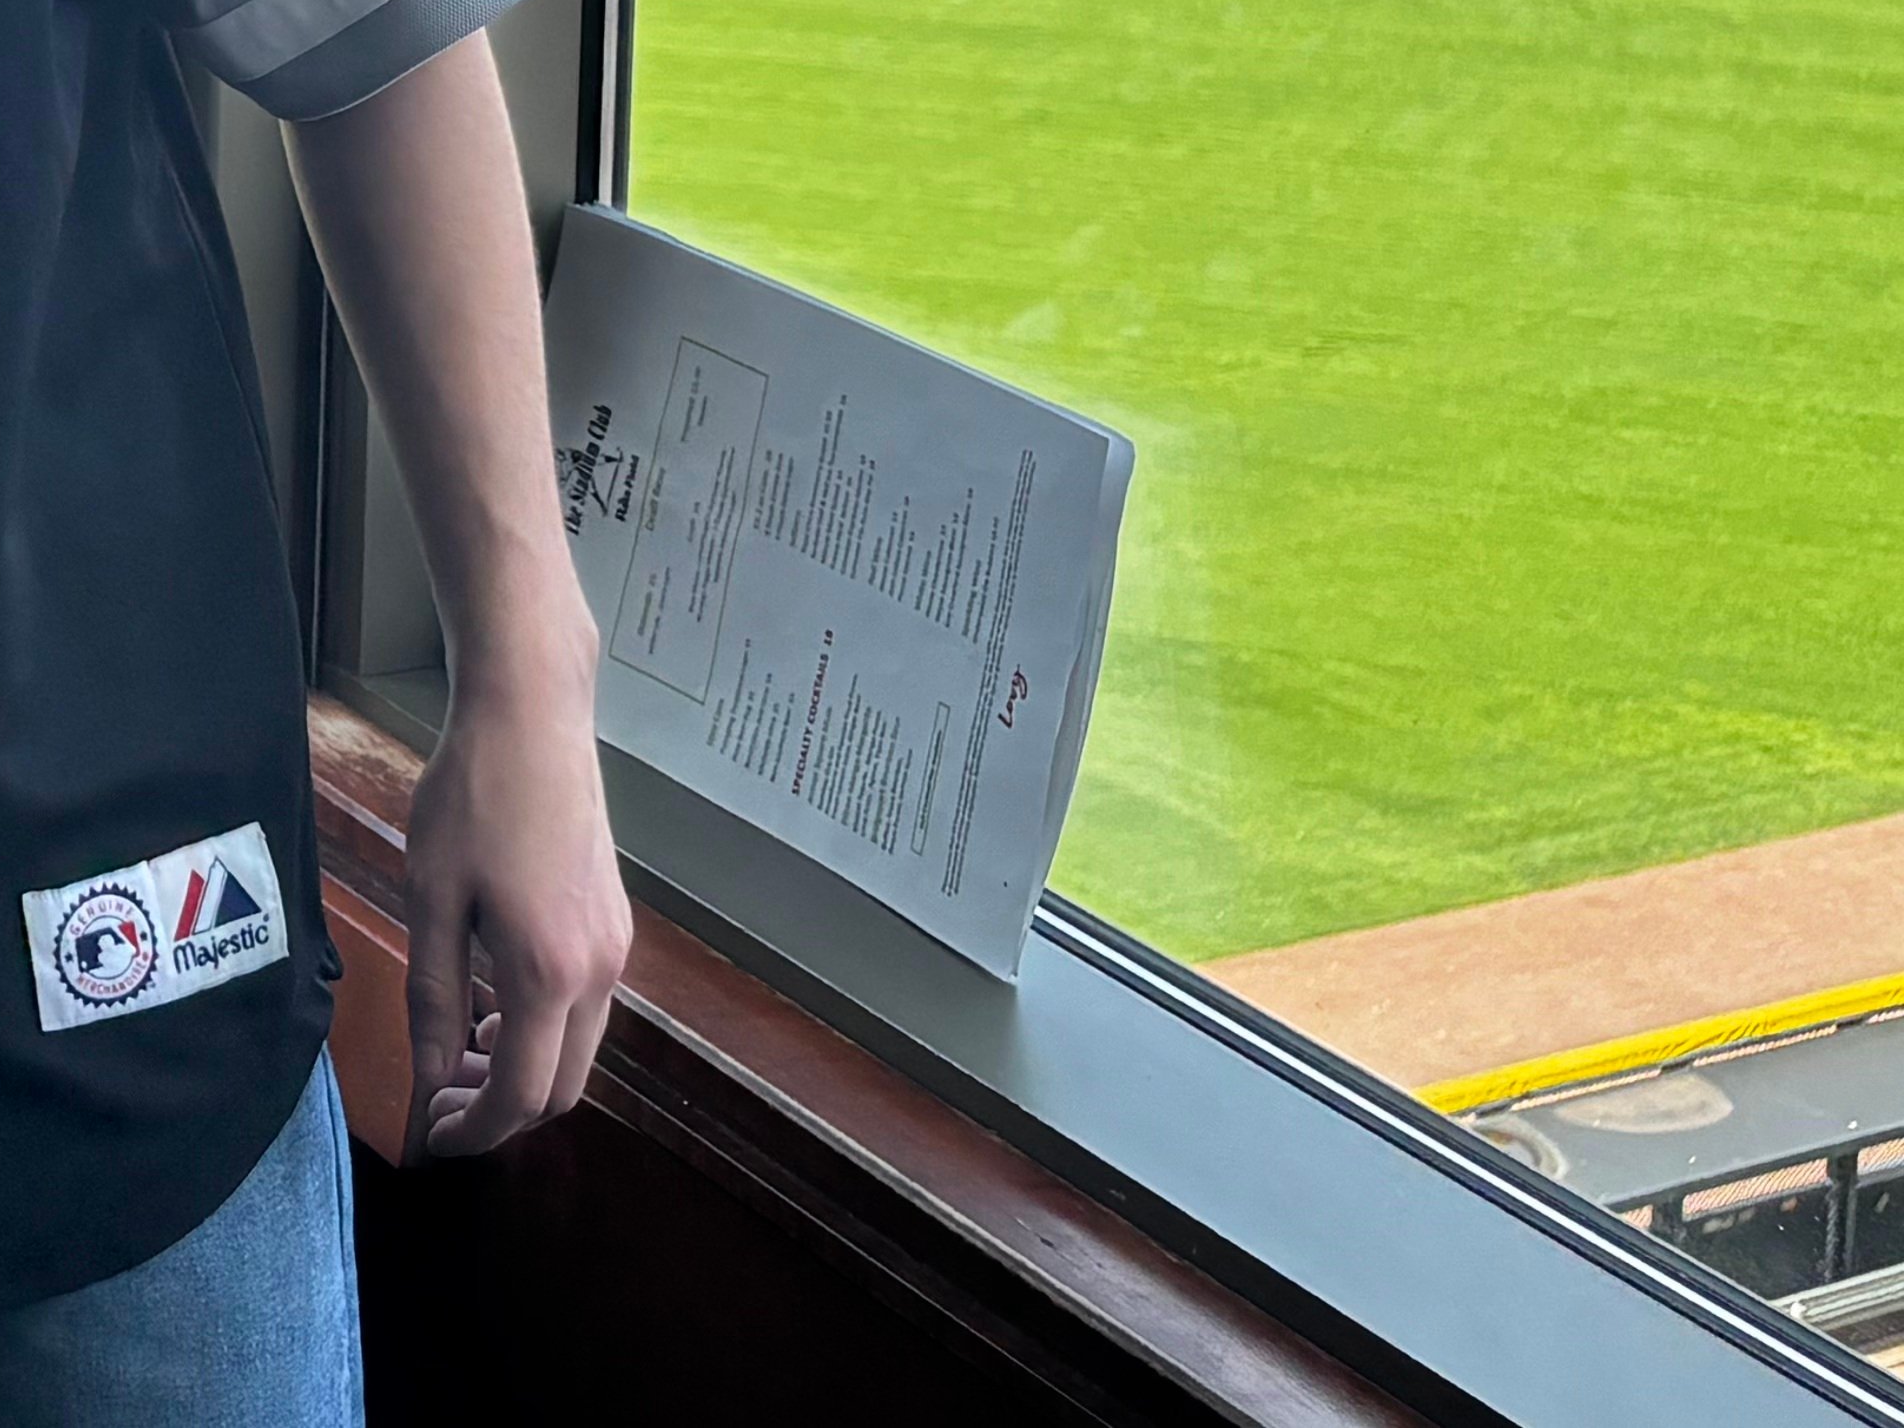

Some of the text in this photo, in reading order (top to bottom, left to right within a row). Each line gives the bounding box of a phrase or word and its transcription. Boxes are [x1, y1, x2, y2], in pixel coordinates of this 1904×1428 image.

[561, 399, 613, 537] The Stadium Club
[790, 724, 814, 798] SPECIALTY
[804, 650, 829, 726] COCKTAILS
[69, 898, 136, 935] GENUINE
[172, 923, 270, 975] Majestic
[75, 962, 149, 996] MERCHANDISE
